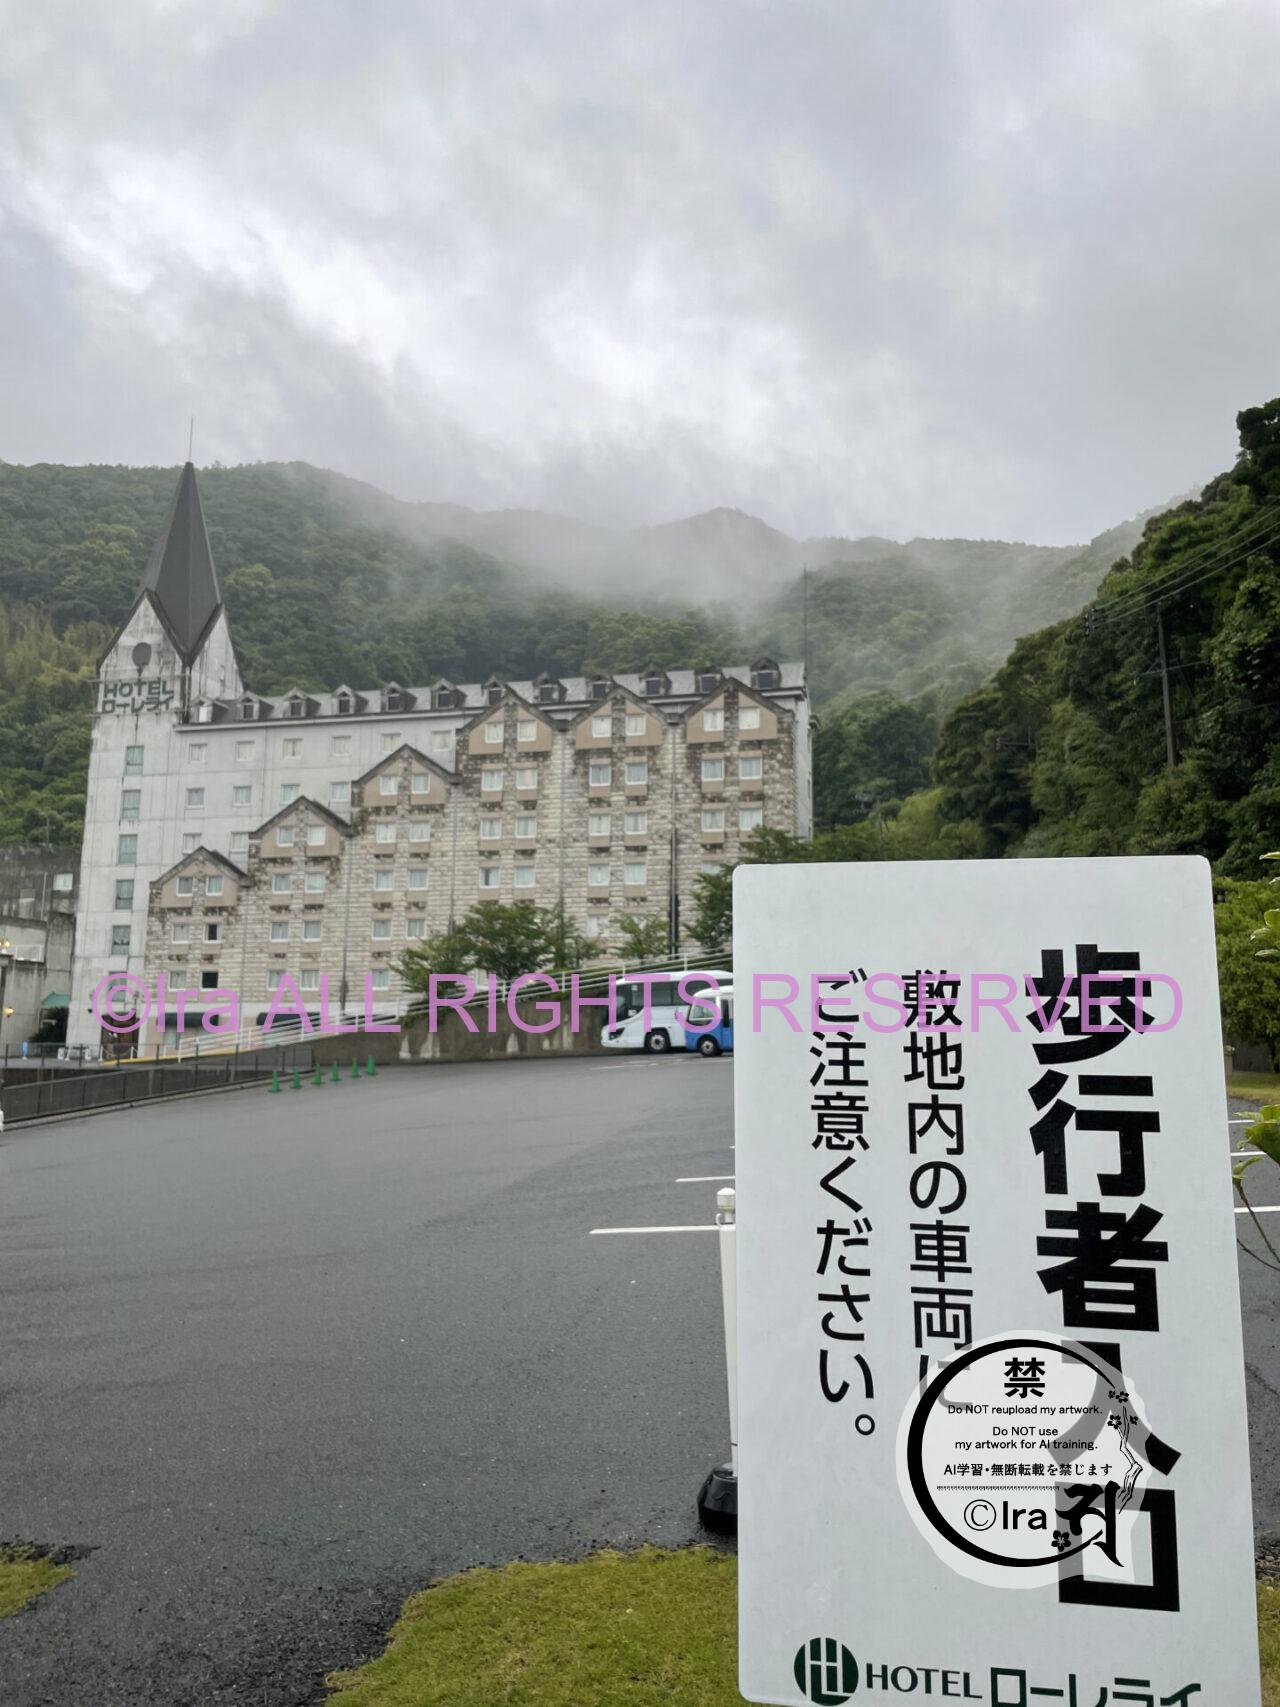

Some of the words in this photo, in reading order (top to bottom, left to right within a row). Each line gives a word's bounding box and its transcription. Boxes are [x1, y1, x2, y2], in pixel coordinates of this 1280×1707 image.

[103, 680, 174, 698] HOTEL
[809, 967, 876, 1436] ご注意ください。
[1024, 943, 1182, 1613] 歩行者入口
[865, 1662, 983, 1700] HOTEL
